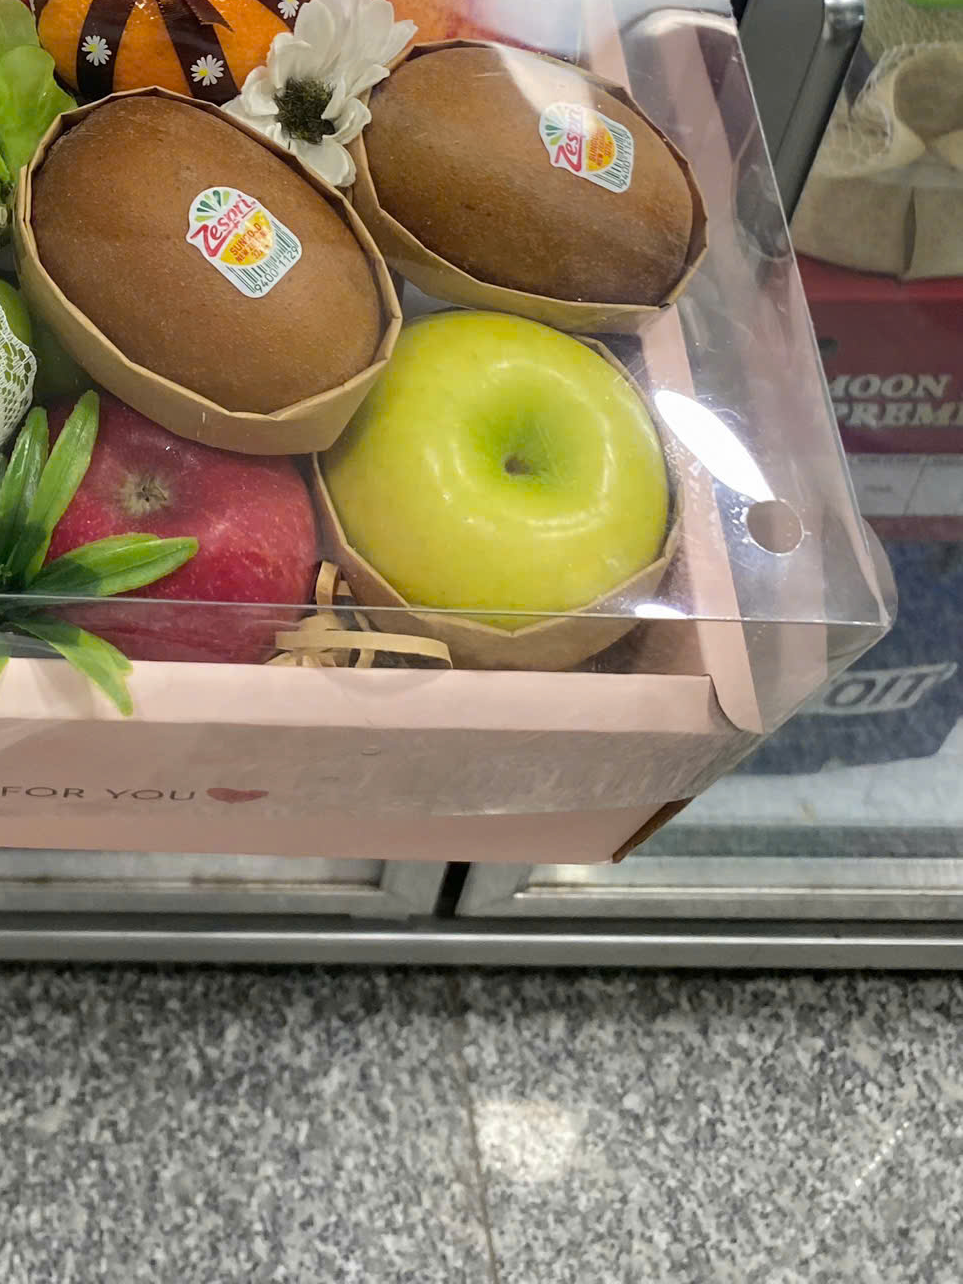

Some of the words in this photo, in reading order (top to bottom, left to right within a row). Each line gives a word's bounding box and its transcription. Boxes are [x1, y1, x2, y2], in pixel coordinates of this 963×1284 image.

[189, 193, 253, 258] Zespri
[229, 221, 262, 256] SUNOD
[1, 786, 85, 799] FOR
[105, 788, 196, 801] YOU
